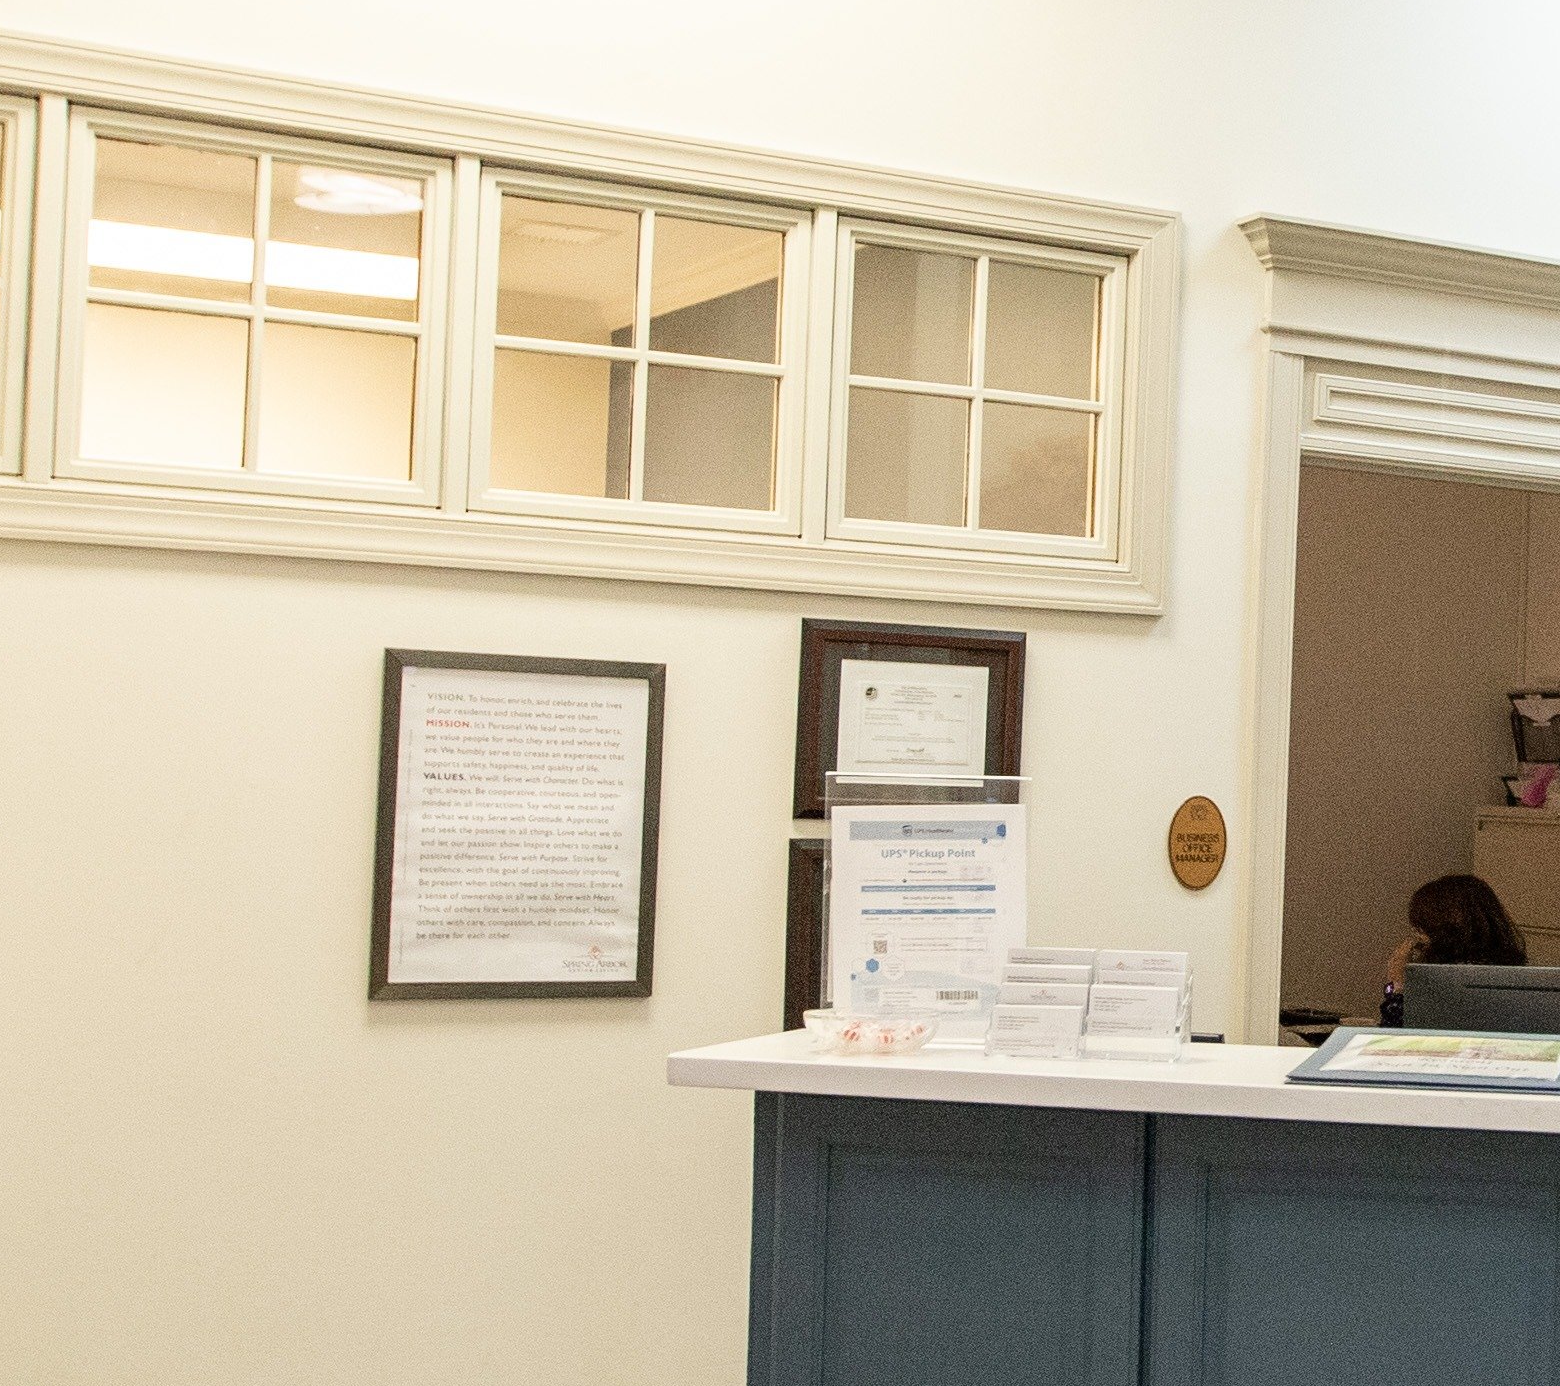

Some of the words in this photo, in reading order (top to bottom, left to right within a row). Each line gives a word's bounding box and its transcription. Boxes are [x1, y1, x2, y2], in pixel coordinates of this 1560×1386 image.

[536, 697, 550, 705] and
[552, 698, 588, 707] celebrate
[590, 700, 604, 708] the
[605, 701, 622, 709] lives
[454, 707, 490, 715] residents
[493, 708, 508, 716] and
[510, 709, 532, 717] those
[535, 710, 552, 718] who
[558, 724, 576, 732] with
[439, 732, 460, 740] value
[462, 733, 489, 743] people
[505, 735, 524, 743] who
[525, 736, 542, 746] they
[456, 746, 486, 756] humbly
[562, 751, 606, 761] experience
[1176, 833, 1220, 843] BUSINESS
[1182, 843, 1213, 853] OFFICE
[909, 849, 945, 859] Pickup
[948, 849, 976, 858] Point
[1175, 854, 1219, 863] MANAGER
